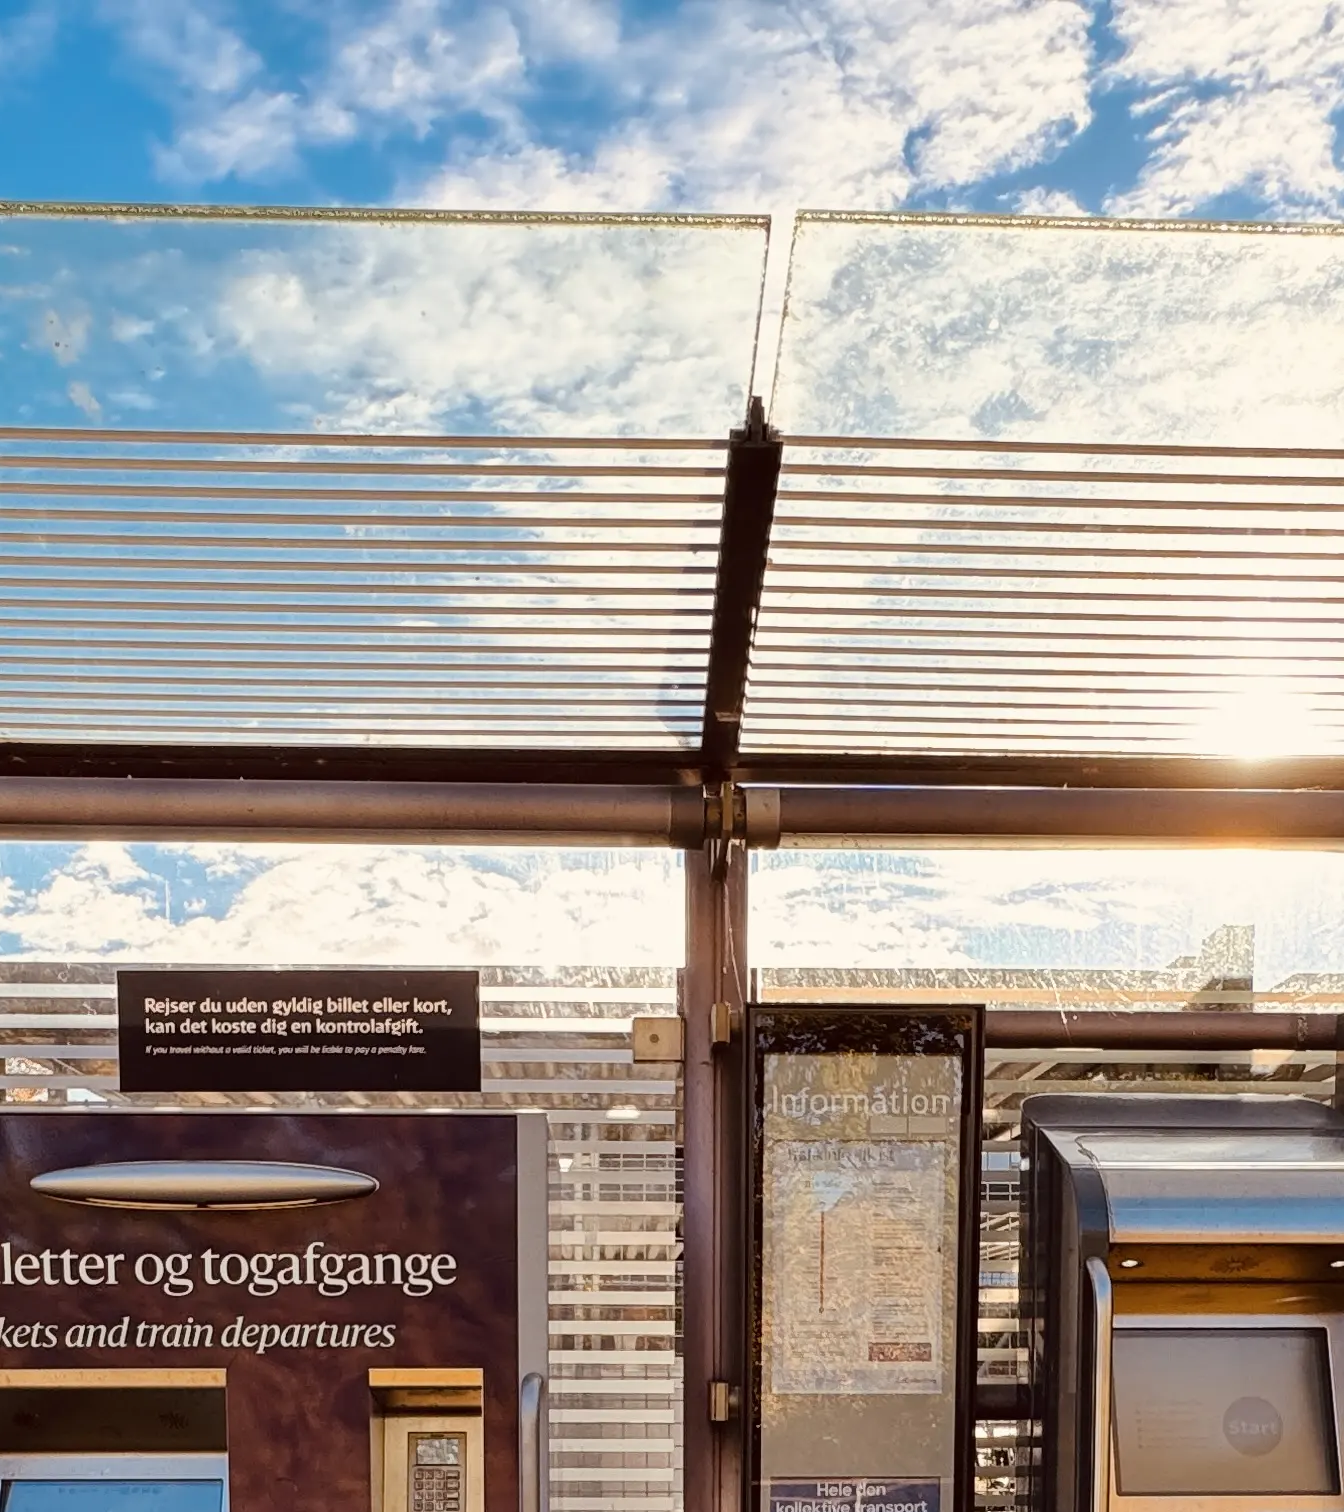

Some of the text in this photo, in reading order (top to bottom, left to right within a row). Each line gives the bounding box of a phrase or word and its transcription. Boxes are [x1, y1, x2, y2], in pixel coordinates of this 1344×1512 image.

[144, 997, 452, 1016] Rejser du uden gyldig billet eller kort,
[145, 1018, 423, 1036] kan det koste dig en kontrolafgift.
[152, 1047, 168, 1056] you
[278, 1046, 293, 1056] you
[354, 1046, 370, 1056] pay
[770, 1085, 951, 1115] Information
[135, 1253, 196, 1297] og
[200, 1241, 457, 1297] togafgange
[65, 1316, 131, 1348] and
[136, 1317, 213, 1348] train
[220, 1315, 397, 1354] departures
[1227, 1419, 1278, 1436] Start
[816, 1481, 886, 1497] Hele den
